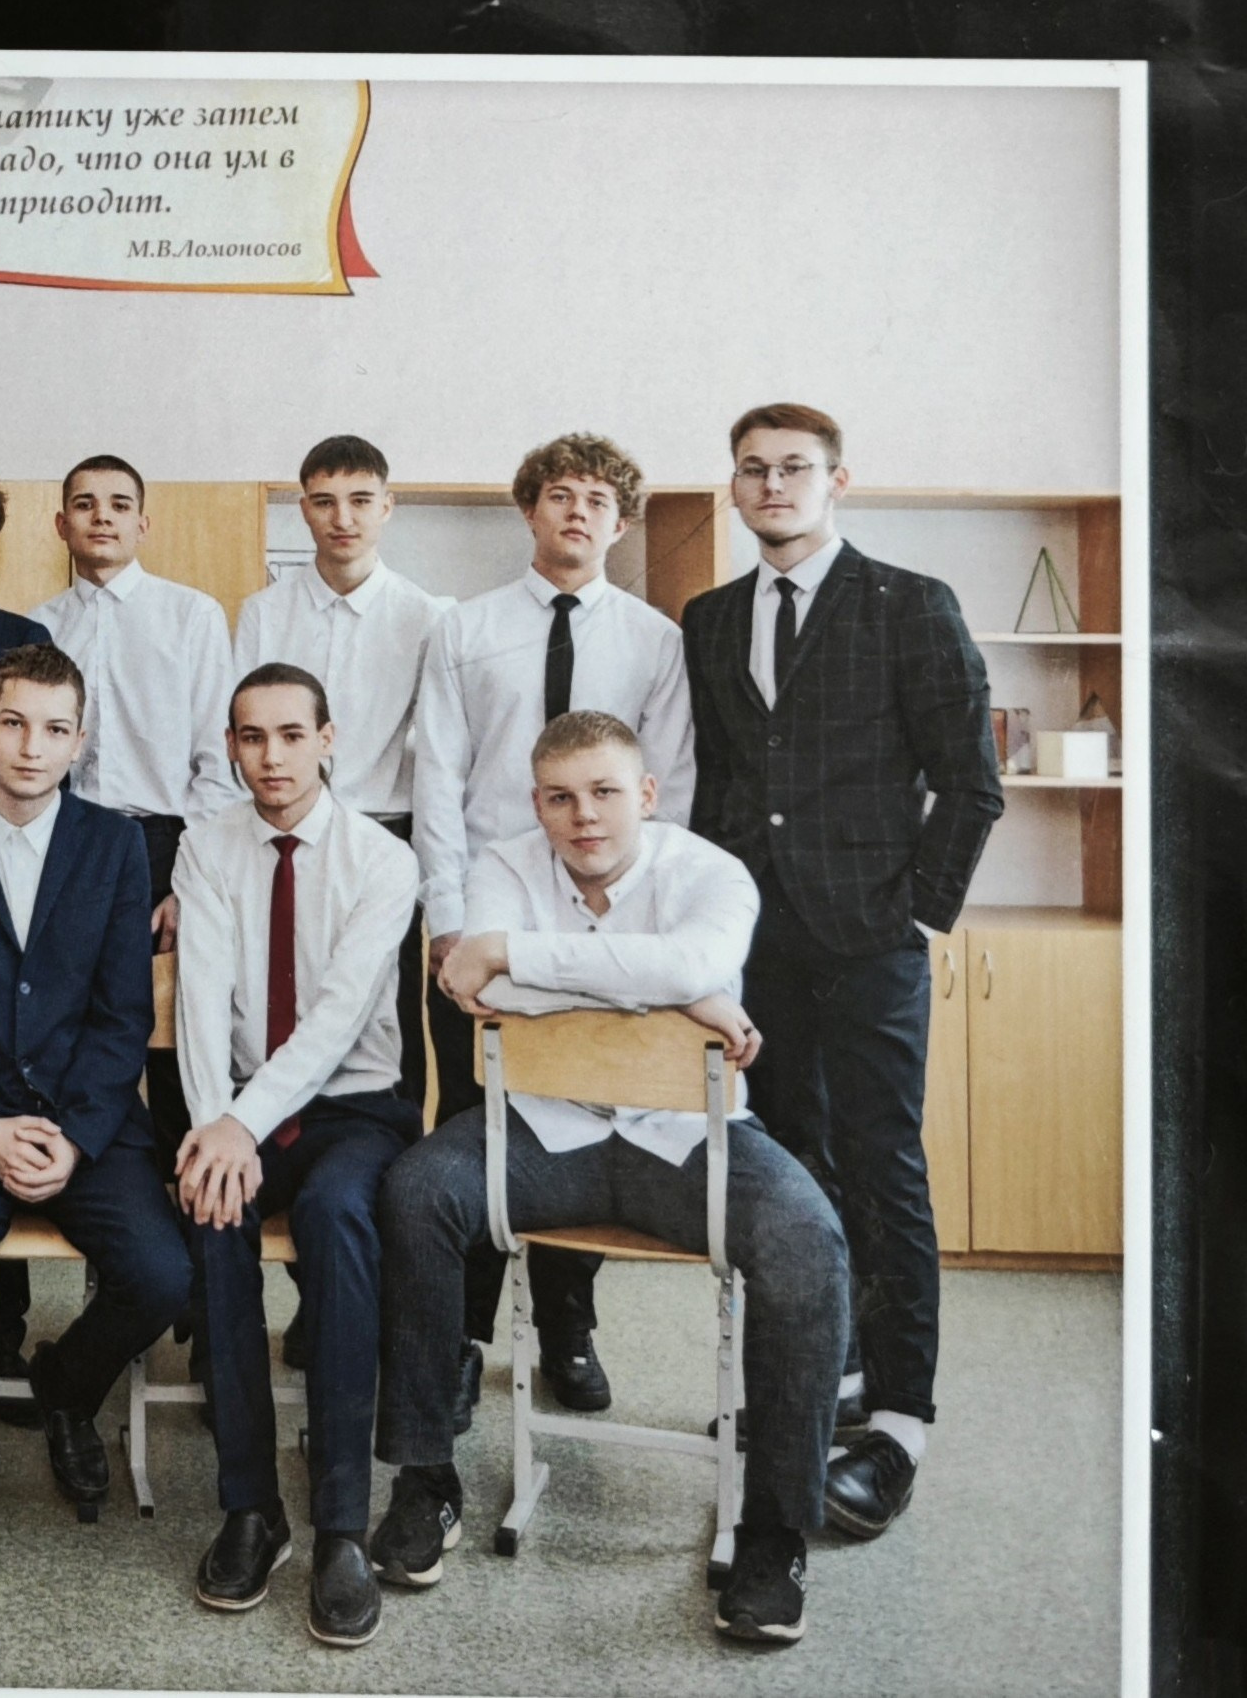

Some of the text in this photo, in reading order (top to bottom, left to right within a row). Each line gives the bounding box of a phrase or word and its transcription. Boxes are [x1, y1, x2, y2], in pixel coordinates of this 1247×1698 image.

[124, 107, 185, 137] уже
[193, 105, 300, 127] затем
[76, 151, 143, 171] что
[153, 150, 212, 170] она
[224, 149, 269, 179] ум
[279, 149, 296, 169] в
[126, 238, 303, 259] М.В.Ломоносов
